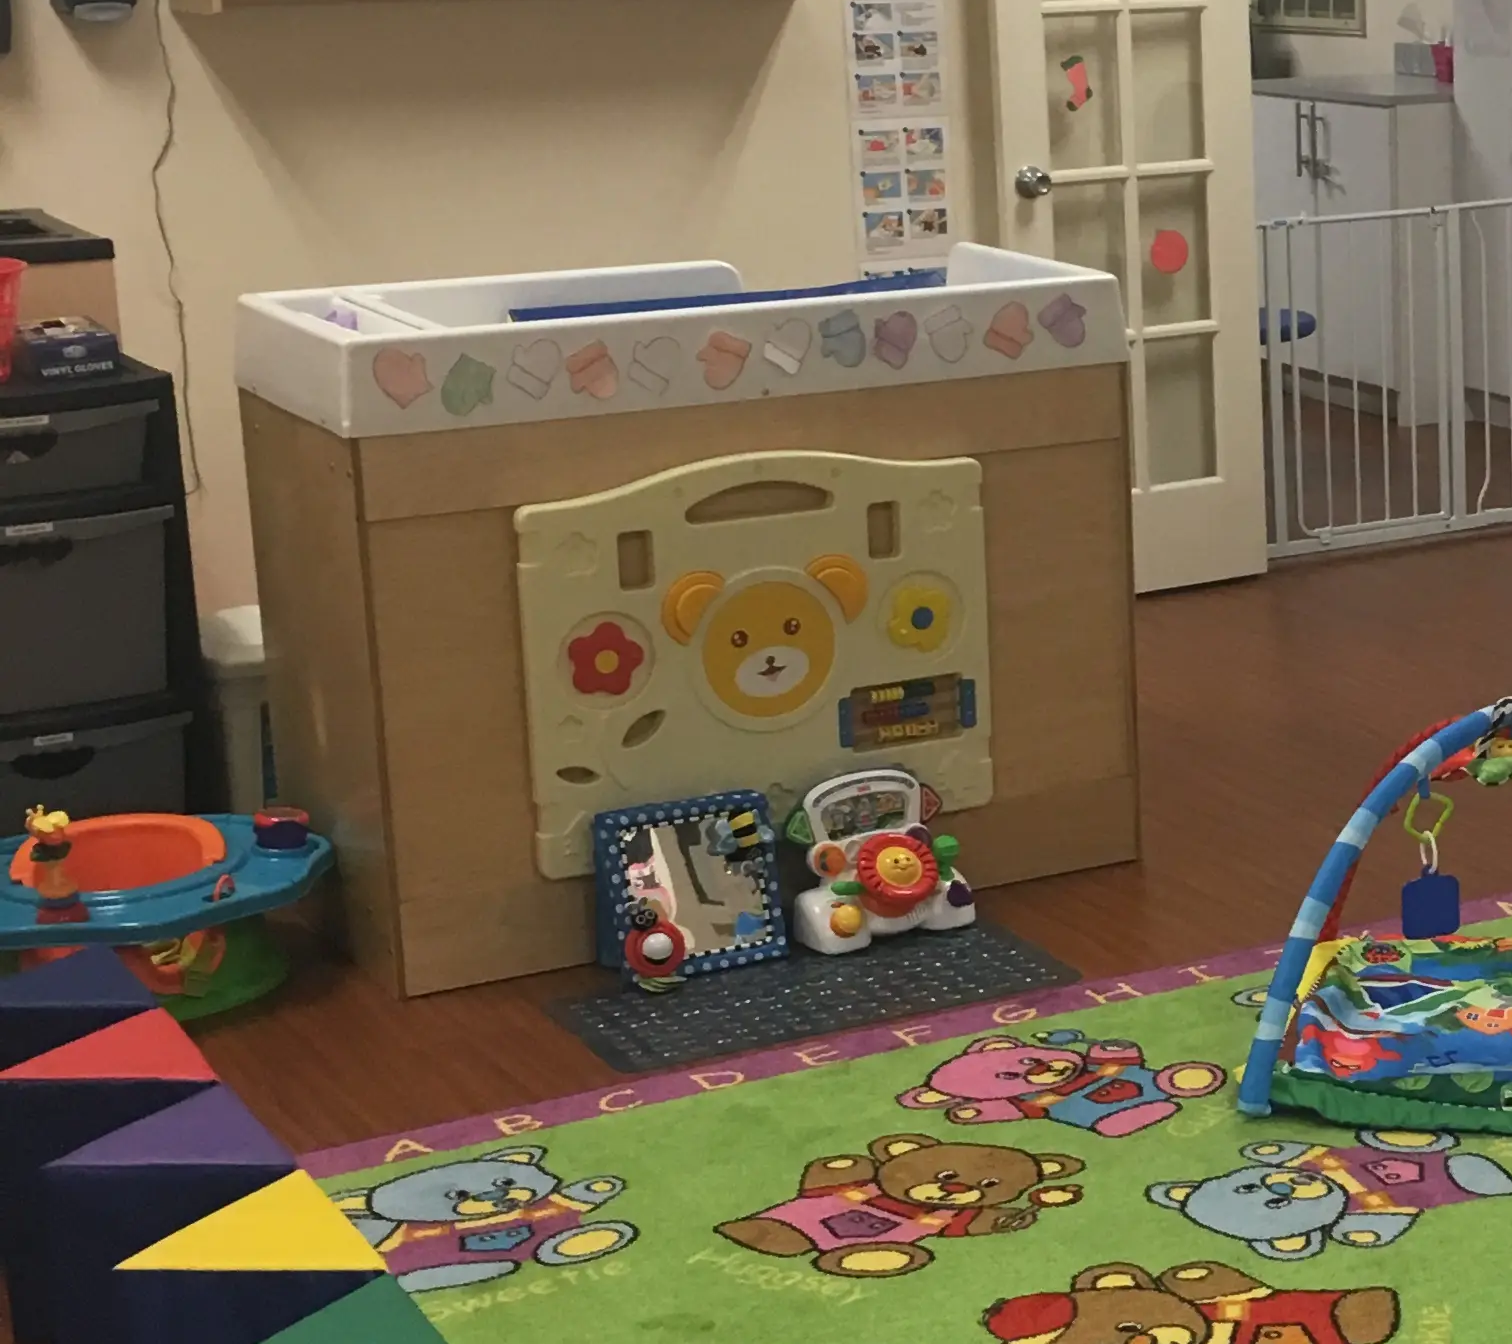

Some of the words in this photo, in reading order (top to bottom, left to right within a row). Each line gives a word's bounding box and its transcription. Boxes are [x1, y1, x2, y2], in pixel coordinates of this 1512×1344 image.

[41, 366, 73, 377] VINYL
[384, 1139, 433, 1162] A
[494, 1114, 543, 1136] B
[599, 1089, 642, 1112] C
[689, 1071, 744, 1090] D
[794, 1045, 838, 1066] E
[892, 1025, 934, 1047] F
[992, 1004, 1037, 1024] G
[1085, 982, 1144, 1004] H
[1177, 965, 1223, 984] I
